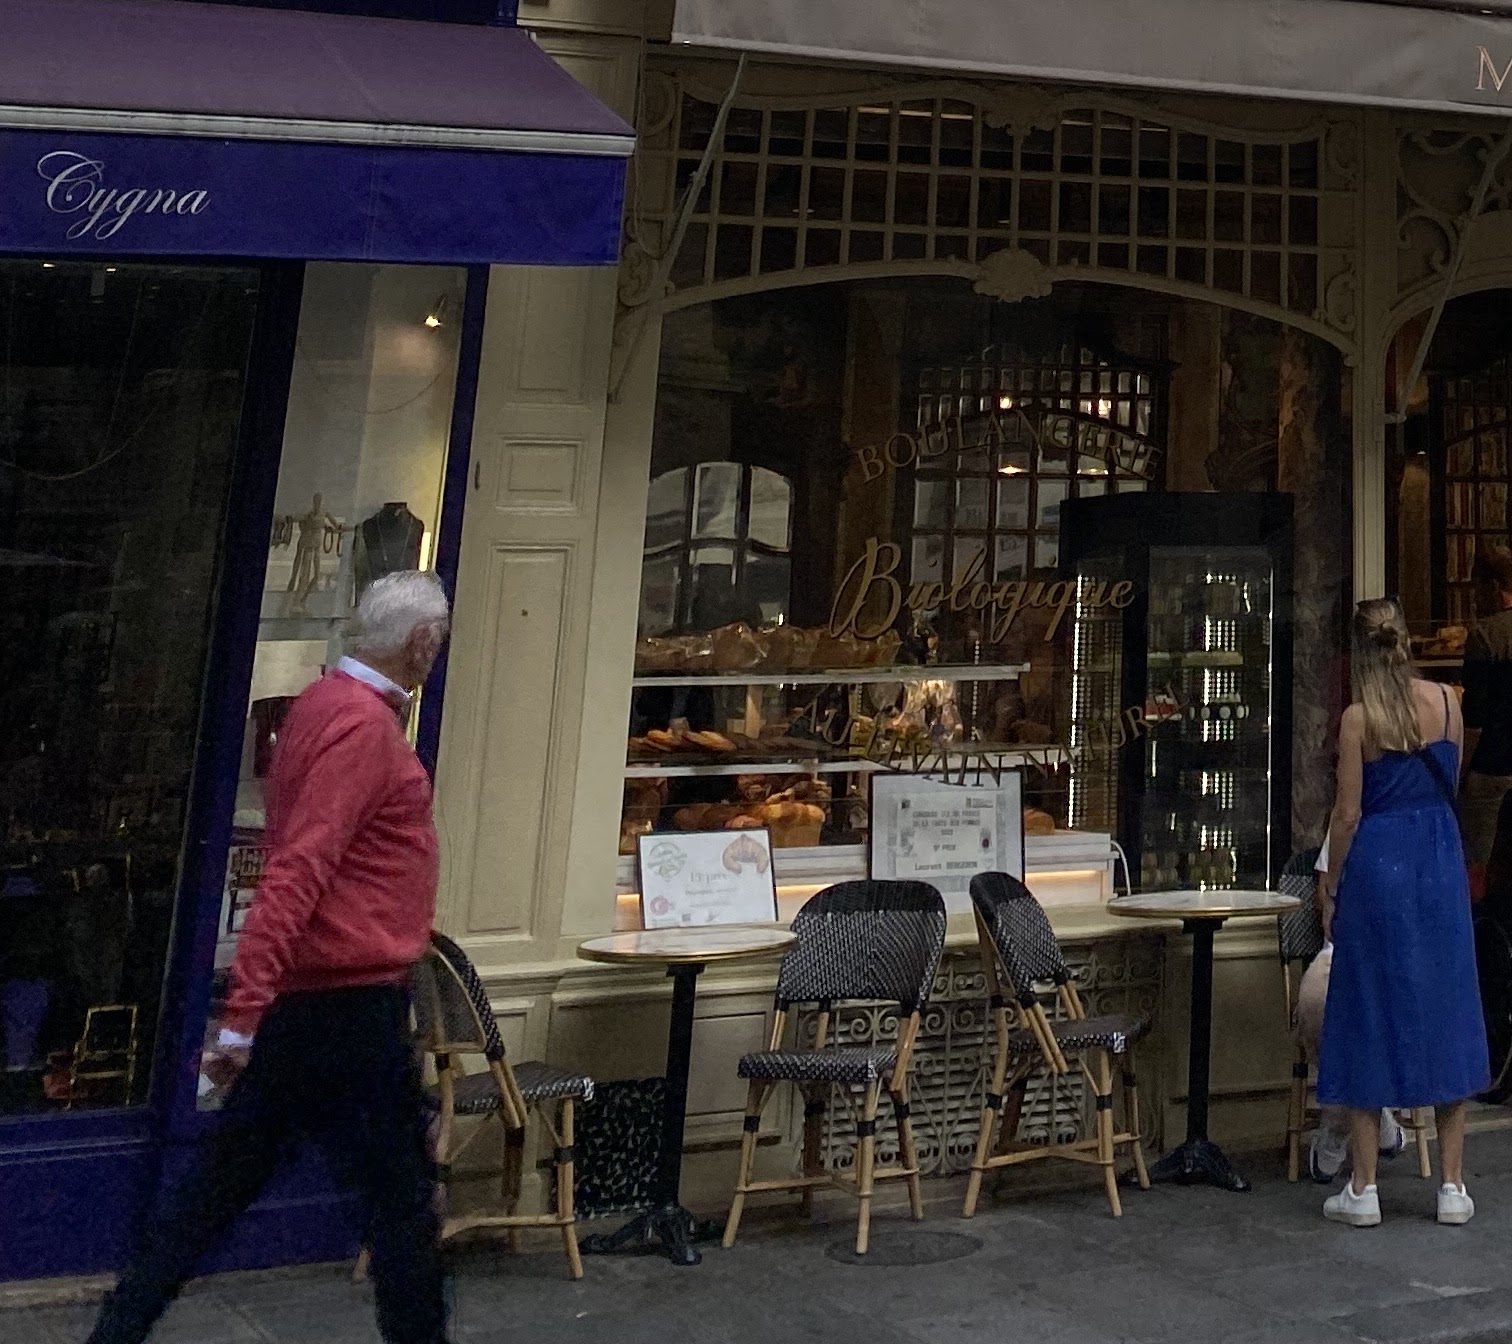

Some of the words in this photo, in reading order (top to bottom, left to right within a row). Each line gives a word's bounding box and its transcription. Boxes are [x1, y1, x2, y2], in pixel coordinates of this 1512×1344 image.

[37, 150, 211, 240] Cygna
[857, 409, 1163, 483] BOULANGERIE
[829, 536, 1135, 644] Biologique
